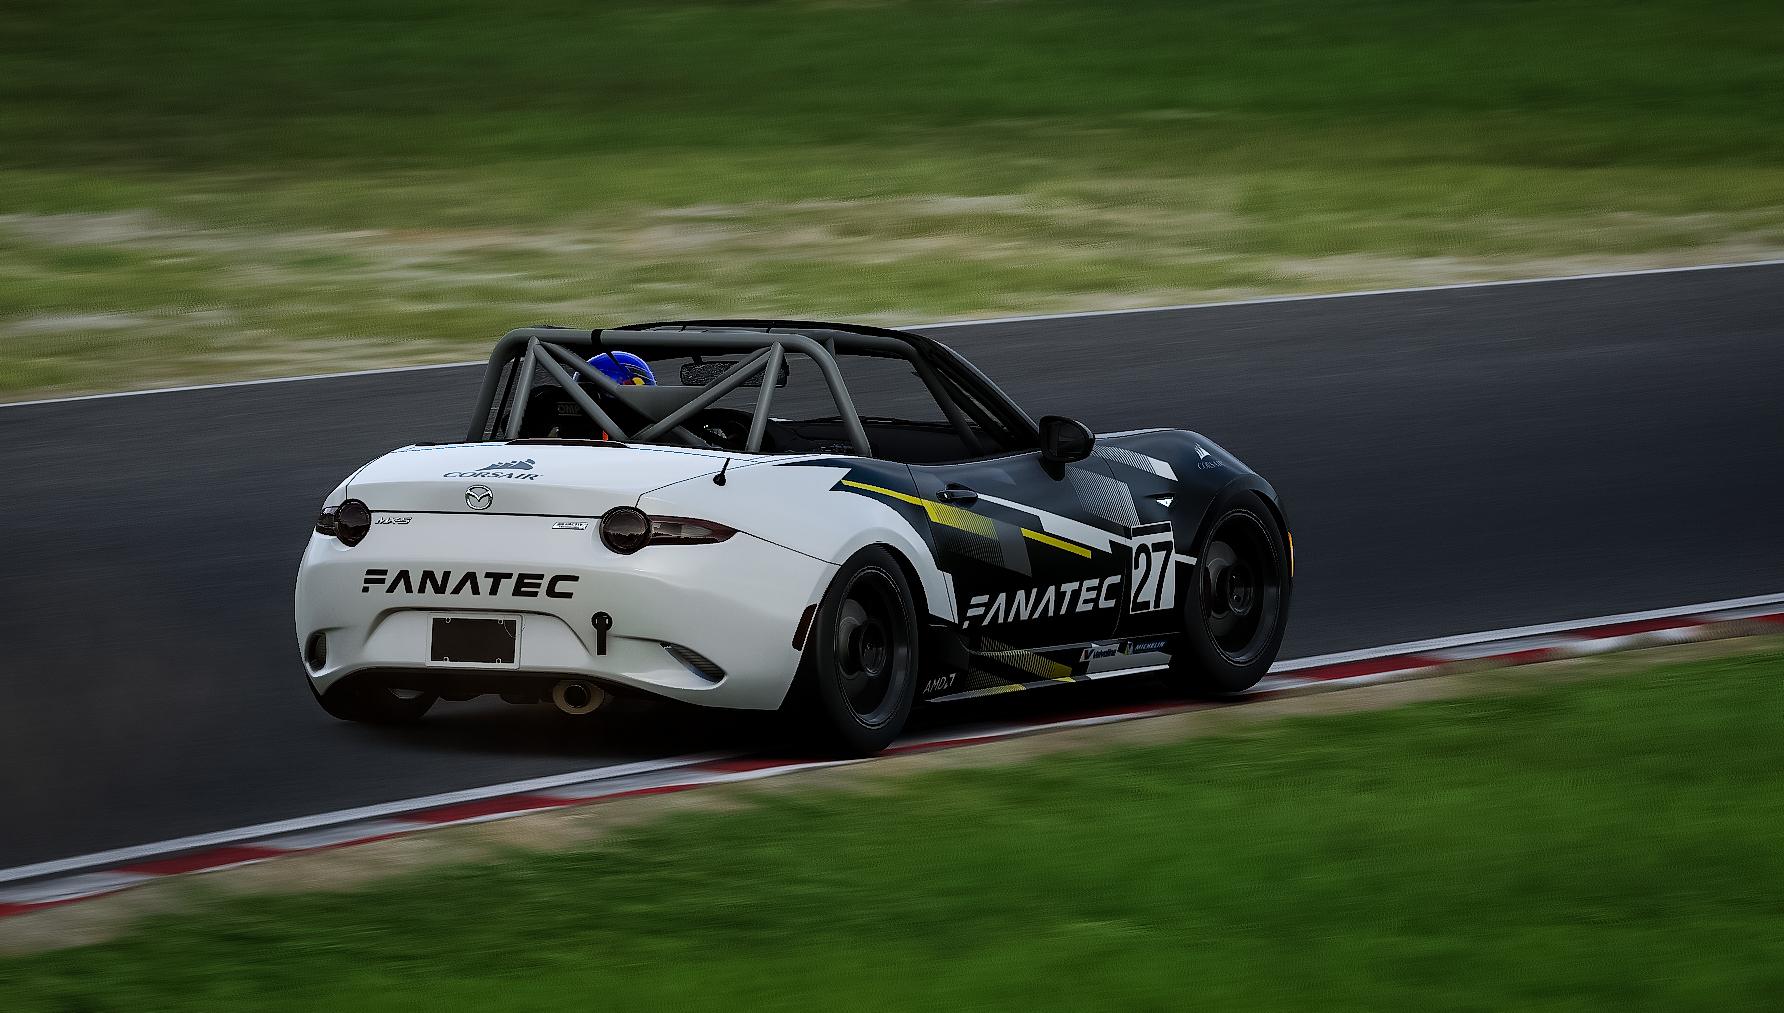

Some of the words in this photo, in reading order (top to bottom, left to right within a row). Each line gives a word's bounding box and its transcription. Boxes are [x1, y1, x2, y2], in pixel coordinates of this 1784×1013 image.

[443, 471, 539, 480] CORSAIR
[361, 568, 580, 599] FANATEC
[1131, 541, 1174, 613] 27
[962, 574, 1121, 629] FANATEC
[1134, 641, 1166, 651] MICHELIN
